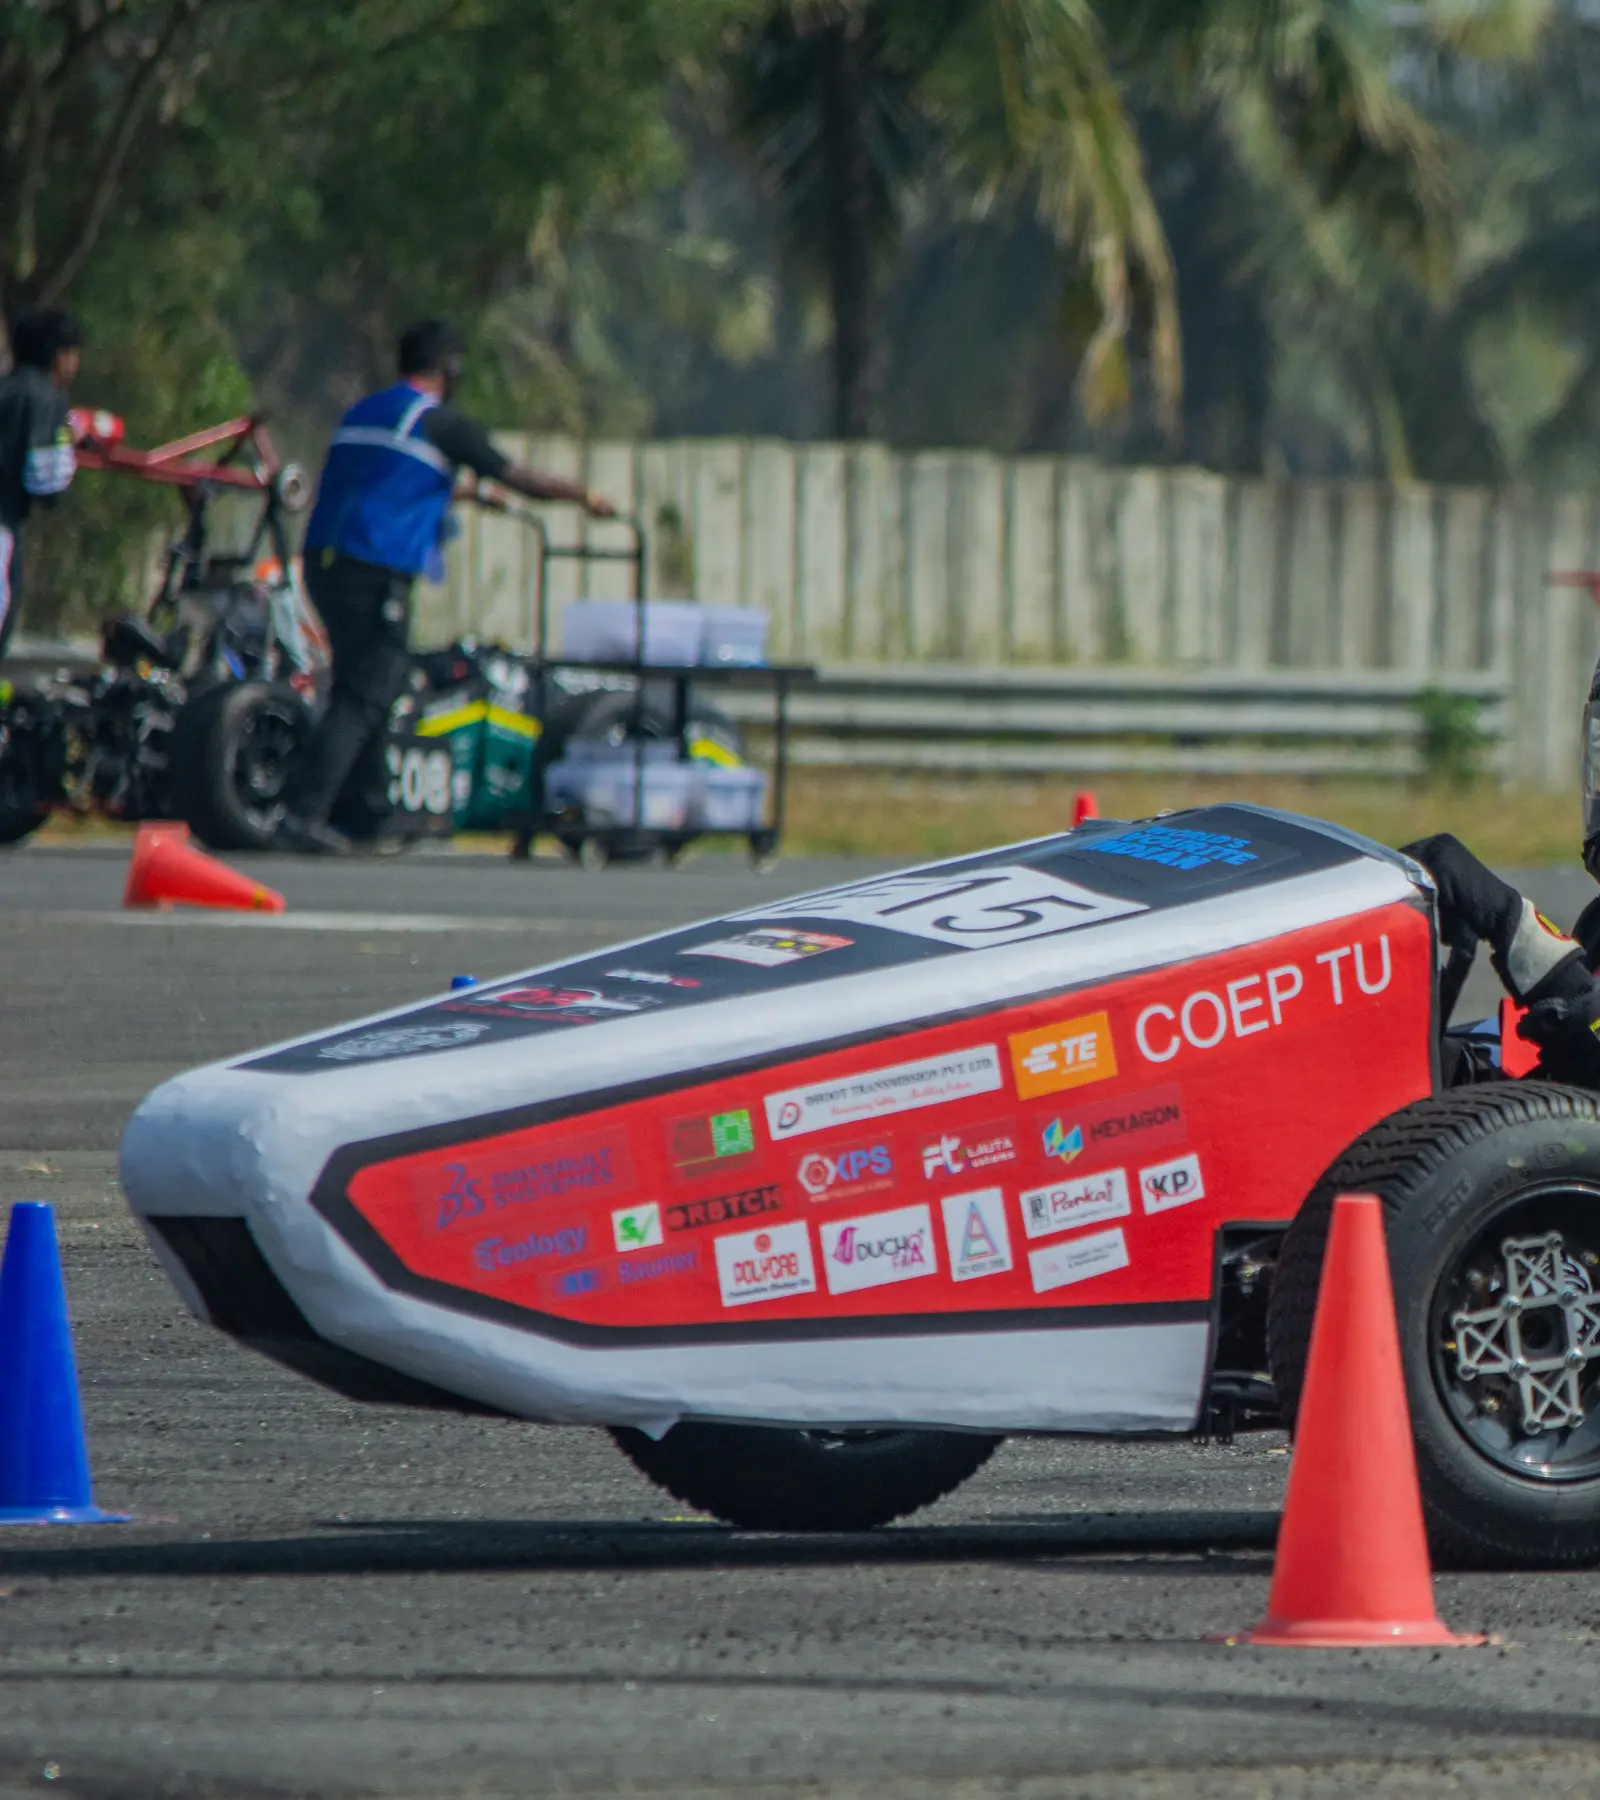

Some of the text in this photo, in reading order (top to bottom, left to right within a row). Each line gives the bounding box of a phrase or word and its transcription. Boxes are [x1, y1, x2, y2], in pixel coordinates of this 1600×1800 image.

[1136, 934, 1392, 1063] COEP TU
[1060, 1032, 1098, 1065] TE
[1089, 1104, 1180, 1141] HEXAGON
[1152, 1170, 1188, 1195] KP
[618, 1251, 696, 1286] Baumer
[732, 1252, 800, 1286] POLYCAB
